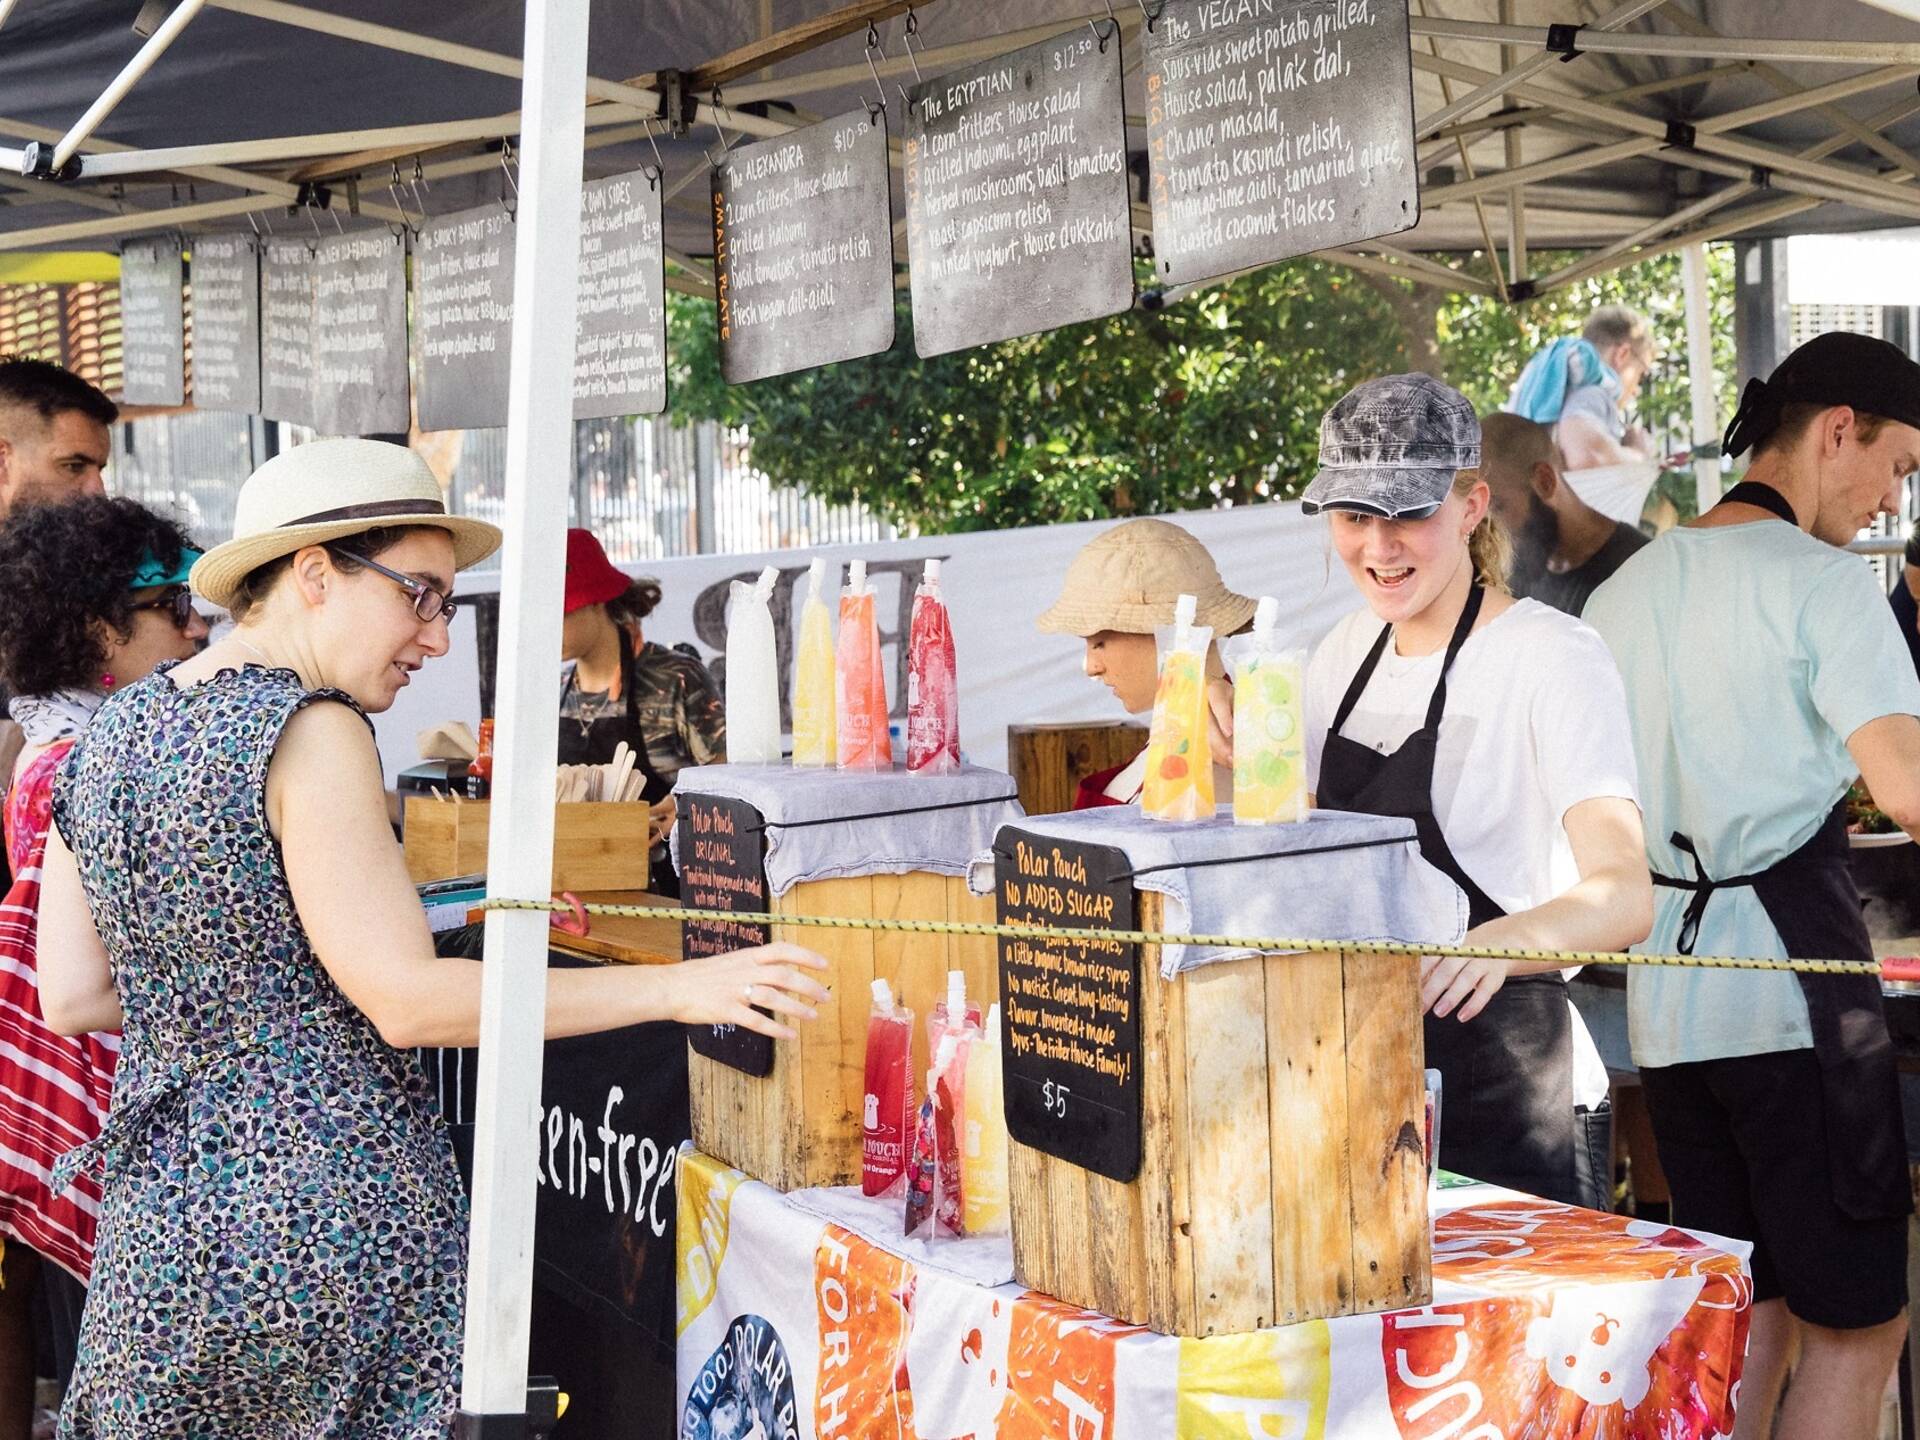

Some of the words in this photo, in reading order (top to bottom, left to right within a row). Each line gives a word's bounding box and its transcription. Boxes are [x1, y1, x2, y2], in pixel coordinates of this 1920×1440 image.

[1164, 16, 1191, 44] The
[1198, 0, 1273, 32] VEGAN
[1224, 38, 1263, 64] sweet
[1264, 18, 1309, 66] potato
[921, 97, 943, 122] The
[946, 68, 1014, 114] EGYPTIAN
[1164, 89, 1202, 120] House
[1205, 76, 1252, 106] salad,
[1257, 54, 1308, 106] palak
[1313, 41, 1351, 83] dal,
[931, 134, 957, 155] corn
[1007, 99, 1041, 129] House
[1042, 82, 1081, 113] salad
[1219, 106, 1285, 140] masala,
[726, 165, 744, 193] The
[745, 144, 804, 182] ALEXANDRA
[922, 153, 964, 191] grilled
[1016, 120, 1077, 167] eggplant
[1168, 152, 1230, 194] tomato
[1296, 117, 1352, 161] relish,
[1247, 172, 1282, 204] aioli,
[1284, 150, 1355, 193] tamarind
[734, 201, 756, 223] corn
[822, 165, 850, 191] salad
[924, 190, 960, 219] herbed
[960, 167, 1036, 203] mushrooms,
[1036, 155, 1066, 189] basil
[1067, 146, 1122, 182] tomatoes
[713, 192, 727, 268] SMALL
[958, 206, 1011, 242] capsicum
[1014, 199, 1053, 228] relish
[1225, 206, 1279, 240] coconut
[1281, 193, 1337, 230] flakes
[730, 225, 765, 265] grilled
[838, 231, 873, 265] relish
[930, 249, 971, 281] minted
[718, 272, 732, 342] PLATE
[1016, 841, 1049, 878] Polar
[1052, 848, 1086, 887] Pouch
[1005, 879, 1021, 907] NO
[1025, 883, 1064, 915] ADDED
[1066, 888, 1114, 922] SUGAR
[1008, 970, 1020, 994] No
[1014, 940, 1033, 966] little
[1063, 949, 1088, 977] brown
[1088, 959, 1105, 982] rice
[1086, 1022, 1116, 1047] made
[1070, 1040, 1095, 1068] House
[1096, 1047, 1131, 1086] Family!
[1042, 1077, 1070, 1118] $5
[734, 1322, 787, 1406] POLAR
